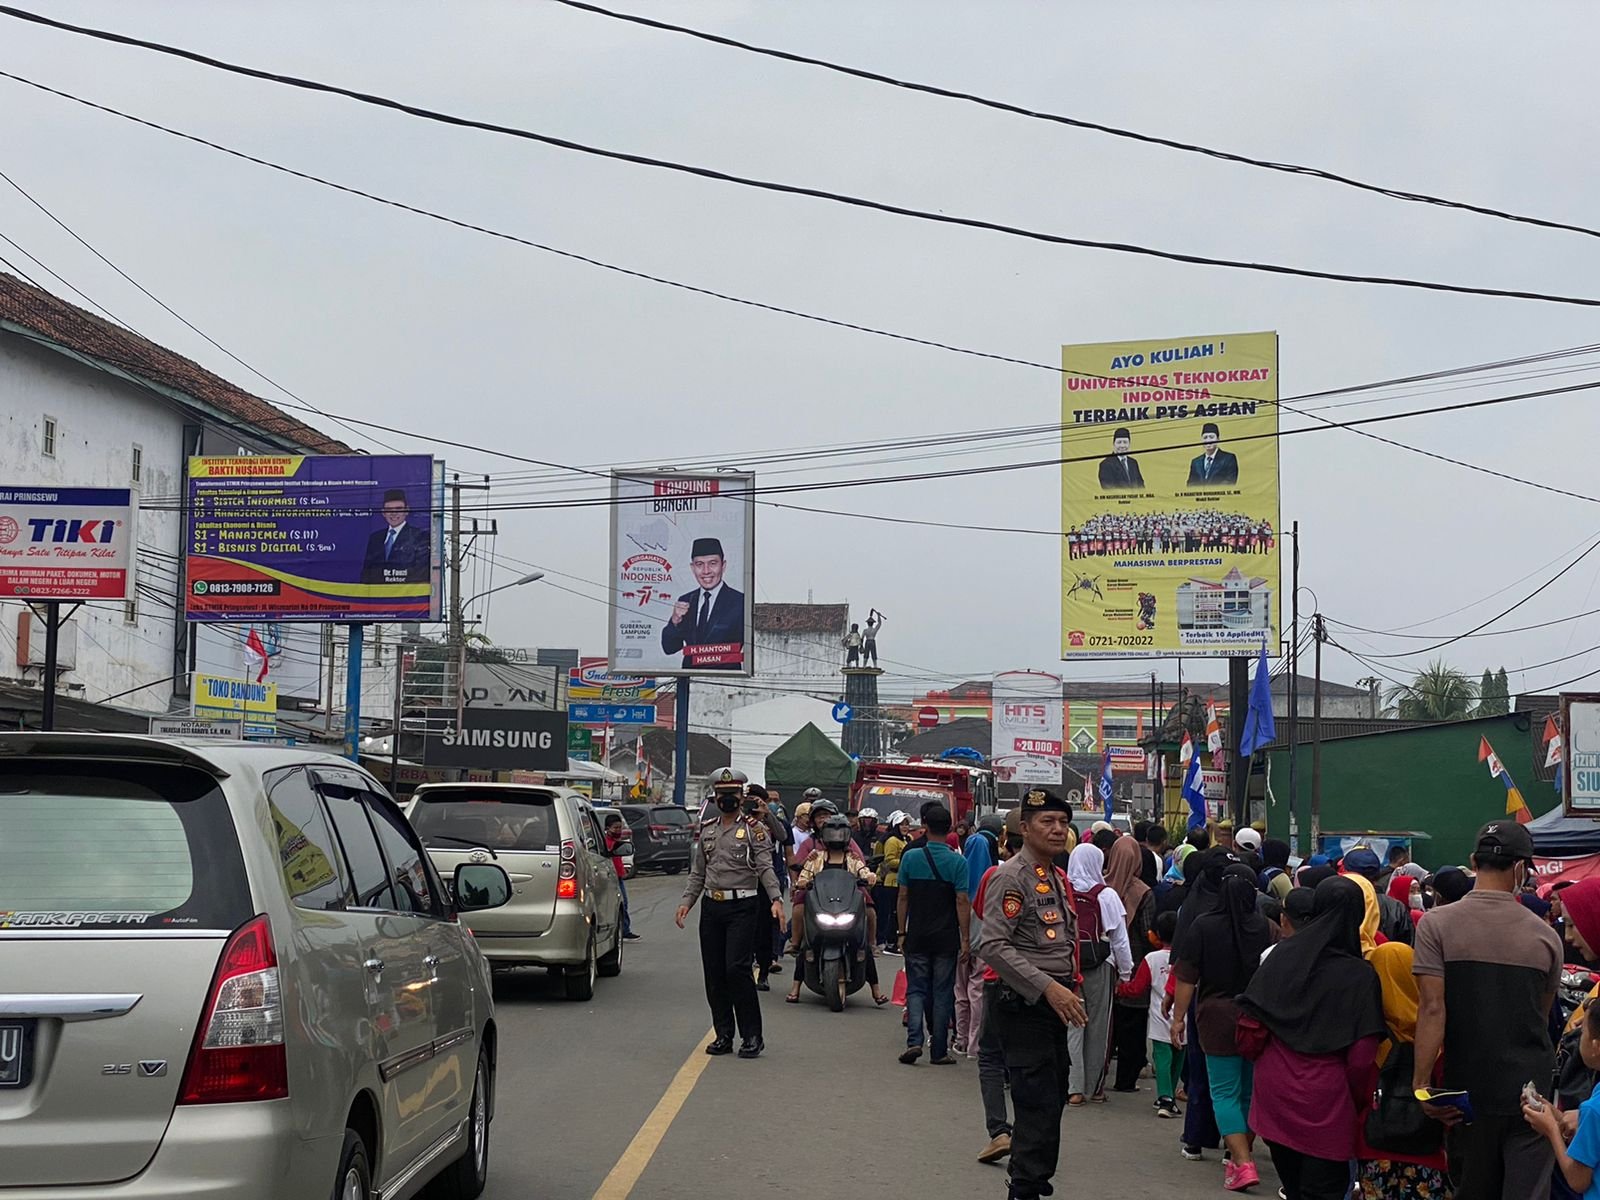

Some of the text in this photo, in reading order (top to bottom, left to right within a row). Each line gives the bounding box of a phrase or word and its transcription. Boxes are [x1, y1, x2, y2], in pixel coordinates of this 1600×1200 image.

[1111, 354, 1144, 370] AYO
[1150, 343, 1214, 365] KULIAH
[1067, 368, 1269, 391] UNIVERSITAS TEKNOKRAT
[1123, 387, 1211, 403] INDONESIA
[1073, 400, 1256, 423] TERBAIK PTS ASEAN
[208, 465, 285, 475] BAKTI NUSANTARA
[660, 480, 711, 496] LAMPUNG
[14, 493, 58, 501] PRINGSEWU
[246, 496, 297, 506] INFORMASI
[194, 530, 207, 540] S1
[219, 530, 287, 540] MANAJEMEN
[27, 546, 50, 557] Satu
[54, 547, 87, 559] Titipan
[91, 548, 116, 558] Kilat
[194, 542, 207, 553] S1
[218, 543, 257, 553] BISNIS
[260, 543, 303, 553] DIGITAL
[1167, 558, 1223, 566] BERPRESTASI
[620, 572, 673, 582] INDONESIA
[31, 587, 90, 595] 0823-7266-3222
[209, 583, 274, 593] 0813-7908-7126
[1089, 635, 1154, 647] 0721-702022
[699, 645, 731, 653] HANTONI
[1005, 704, 1046, 717] HITS
[180, 721, 212, 729] NOTARIS
[1006, 716, 1029, 724] MILD
[442, 727, 552, 749] SAMSUNG
[1110, 746, 1144, 756] Alfamart
[382, 767, 429, 780] SRBA
[2, 1029, 18, 1062] U
